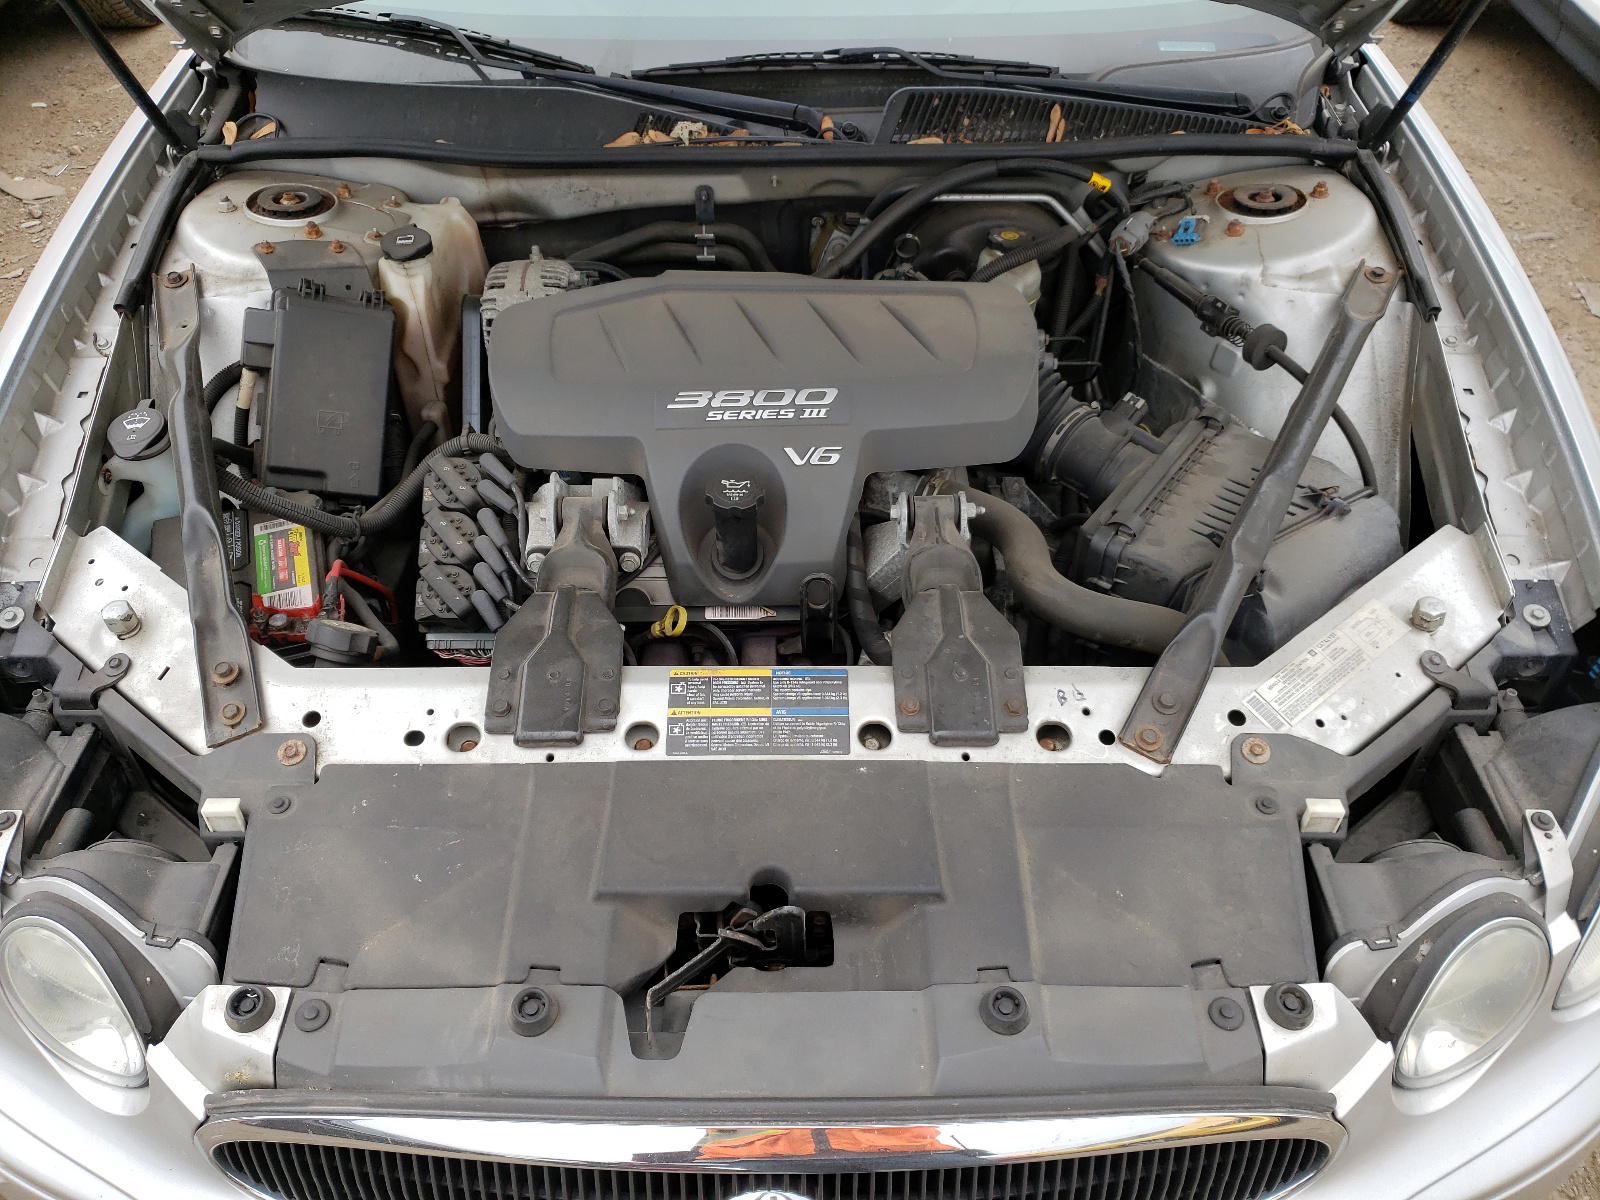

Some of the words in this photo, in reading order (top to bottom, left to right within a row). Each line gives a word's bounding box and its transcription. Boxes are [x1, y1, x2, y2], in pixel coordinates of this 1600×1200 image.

[667, 387, 839, 409] 3800
[706, 408, 795, 421] SERIES
[800, 407, 831, 418] III
[783, 446, 843, 466] V6
